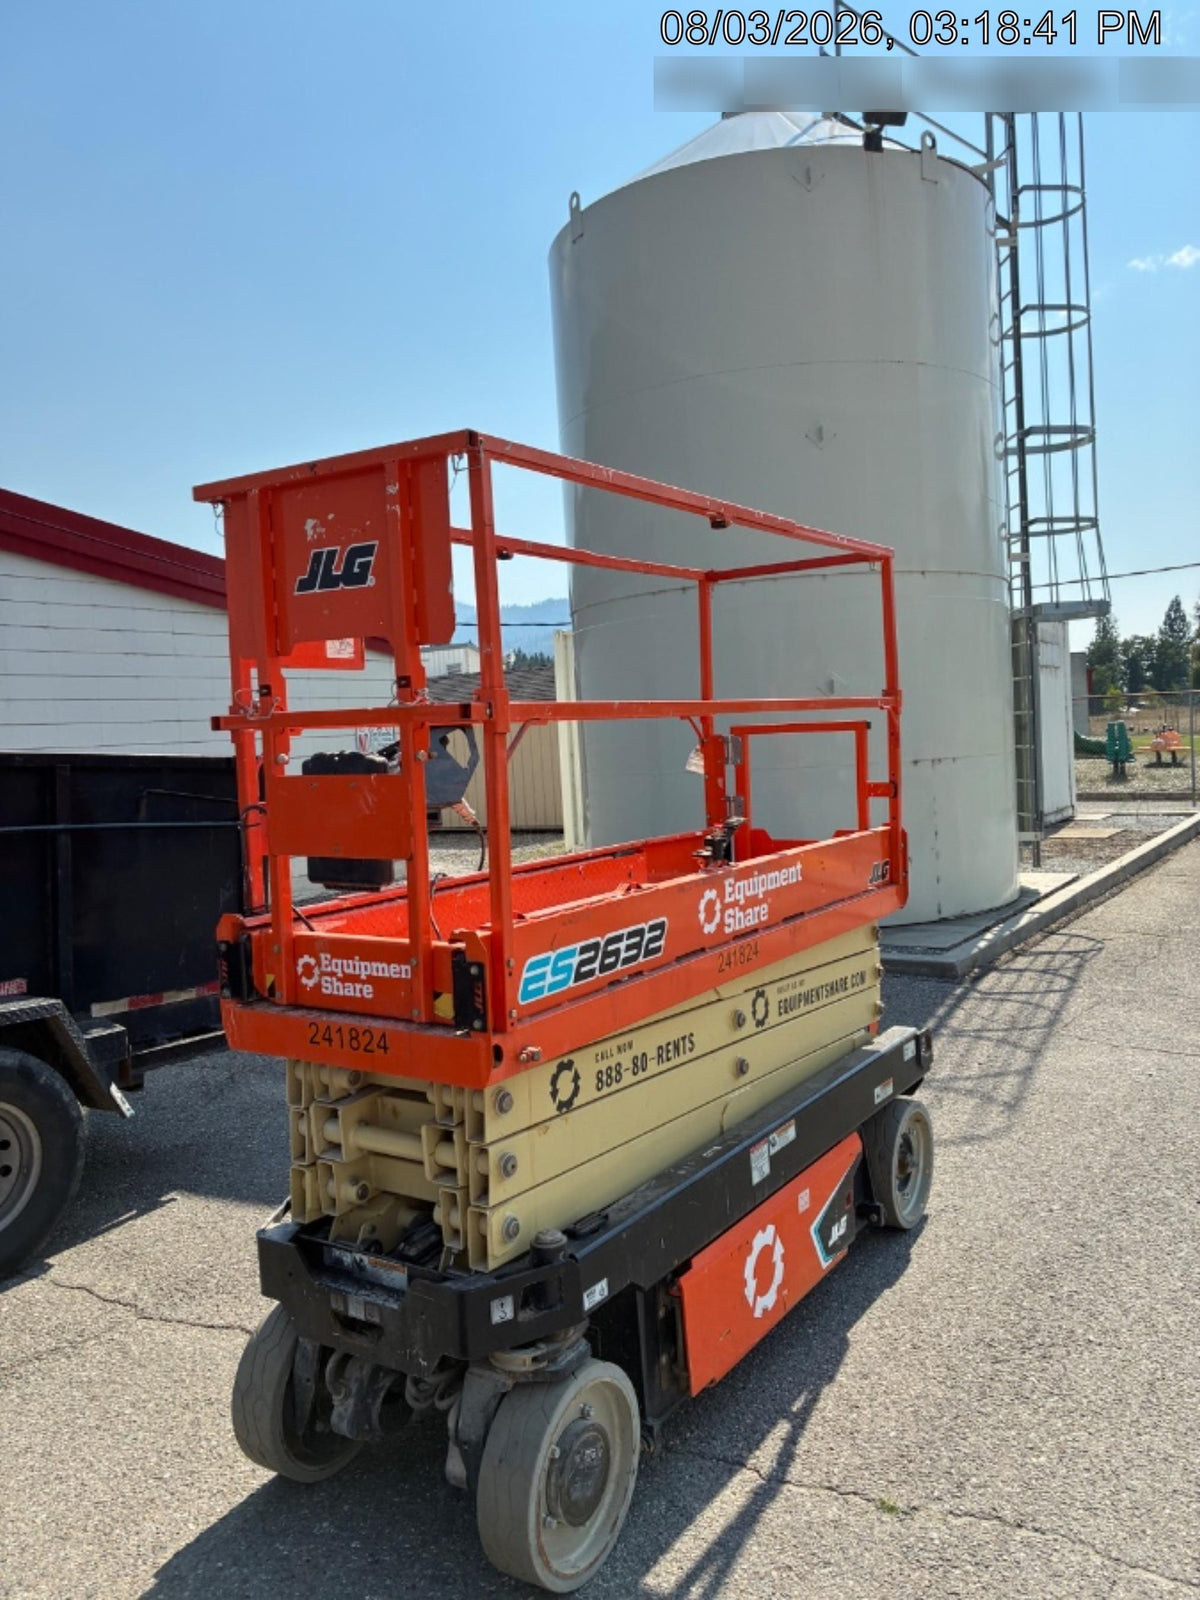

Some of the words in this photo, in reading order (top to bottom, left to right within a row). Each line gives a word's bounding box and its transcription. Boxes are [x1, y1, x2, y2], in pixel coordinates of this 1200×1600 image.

[294, 541, 378, 596] JLG
[724, 861, 803, 905] Equipment
[724, 902, 769, 934] Share
[319, 952, 412, 980] Equipmen
[518, 917, 668, 1005] ES2632
[718, 942, 759, 974] 241824
[321, 976, 374, 998] Share
[778, 970, 867, 1017] EQUIPMENTSHARECOM
[308, 1022, 389, 1055] 241824
[595, 1048, 614, 1063] CALL
[616, 1040, 634, 1055] NOW
[595, 1032, 695, 1092] 888-80-RENTS
